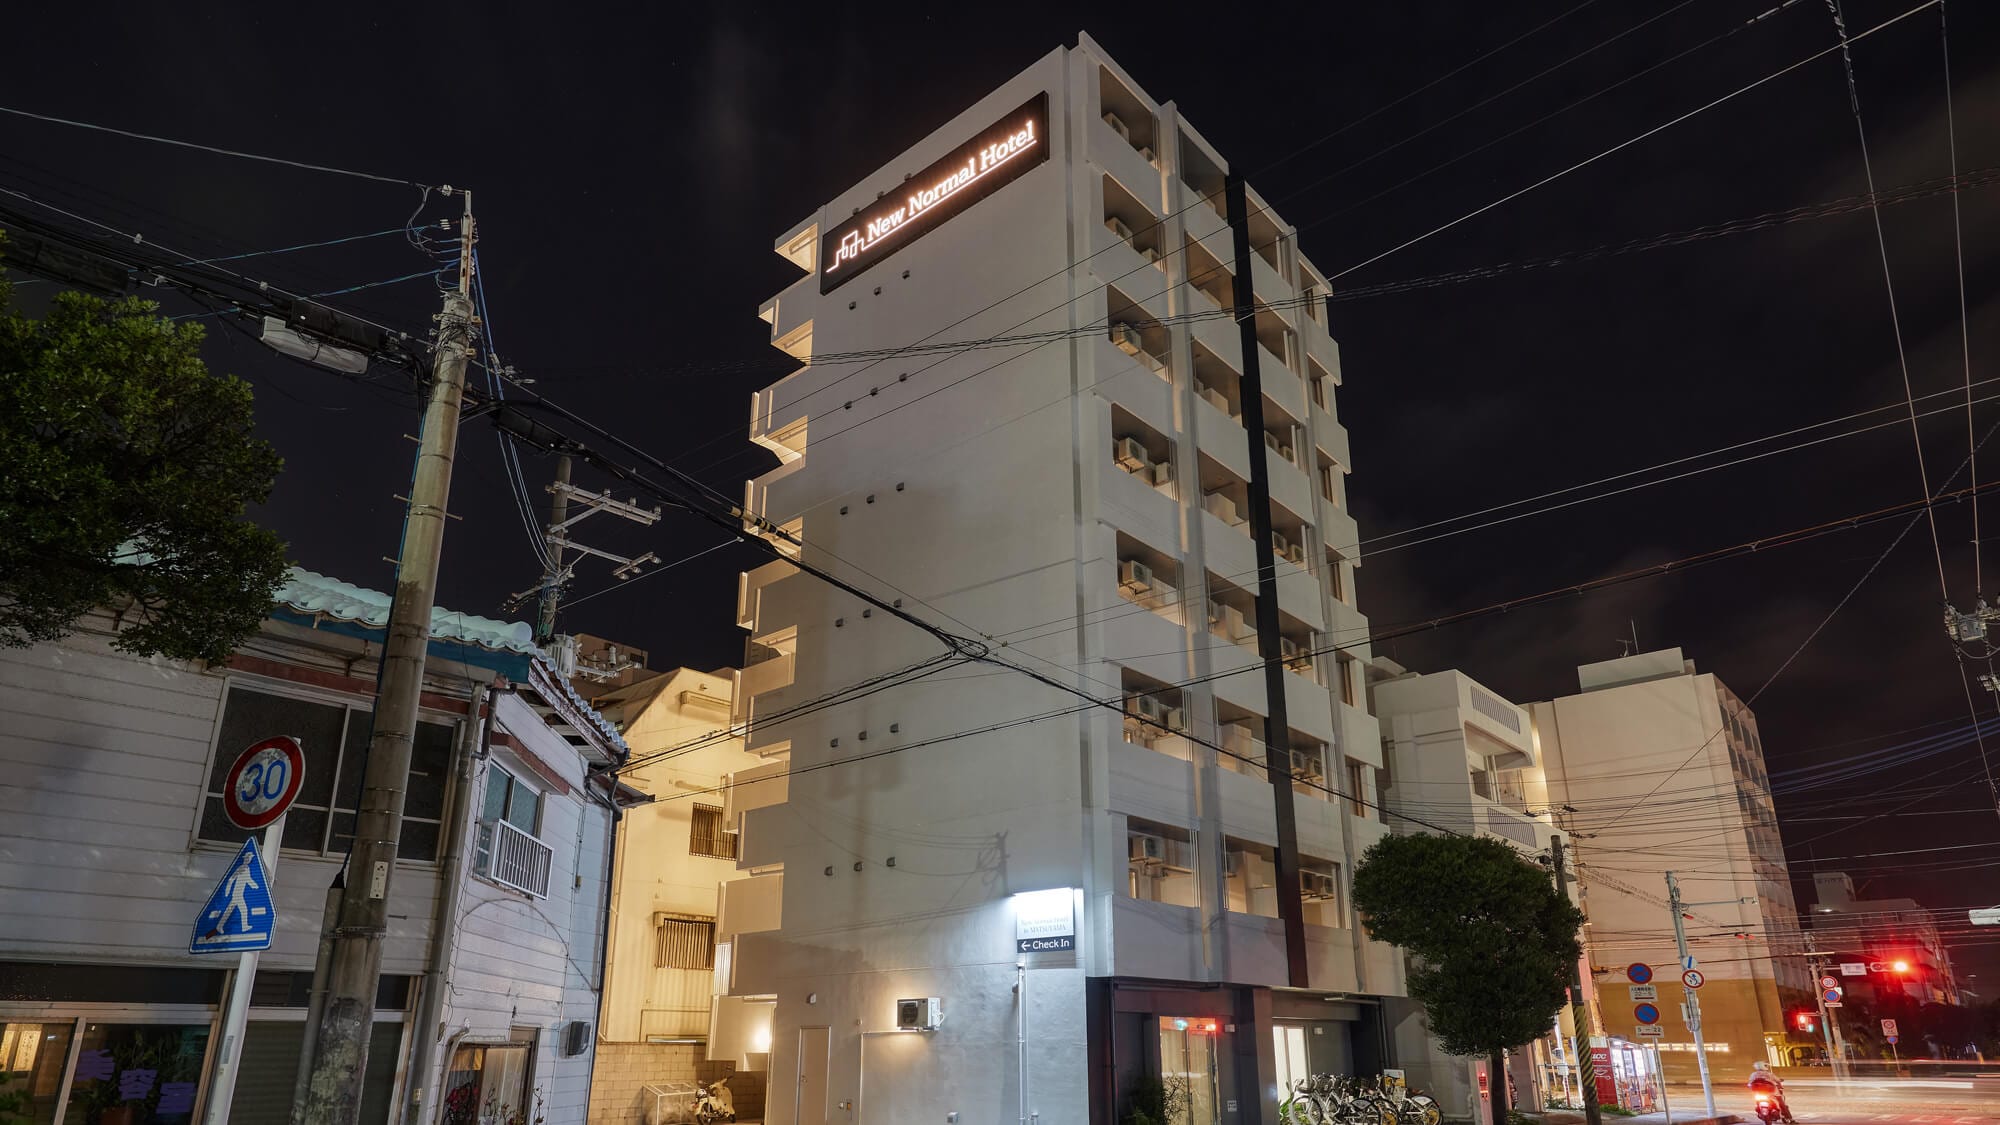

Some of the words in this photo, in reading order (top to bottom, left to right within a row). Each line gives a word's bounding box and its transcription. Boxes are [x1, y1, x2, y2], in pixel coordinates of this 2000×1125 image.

[866, 208, 906, 242] New
[908, 158, 976, 216] Normal
[979, 119, 1034, 172] Hotel
[241, 759, 286, 802] 30
[1032, 940, 1060, 949] Check
[1061, 939, 1070, 947] In
